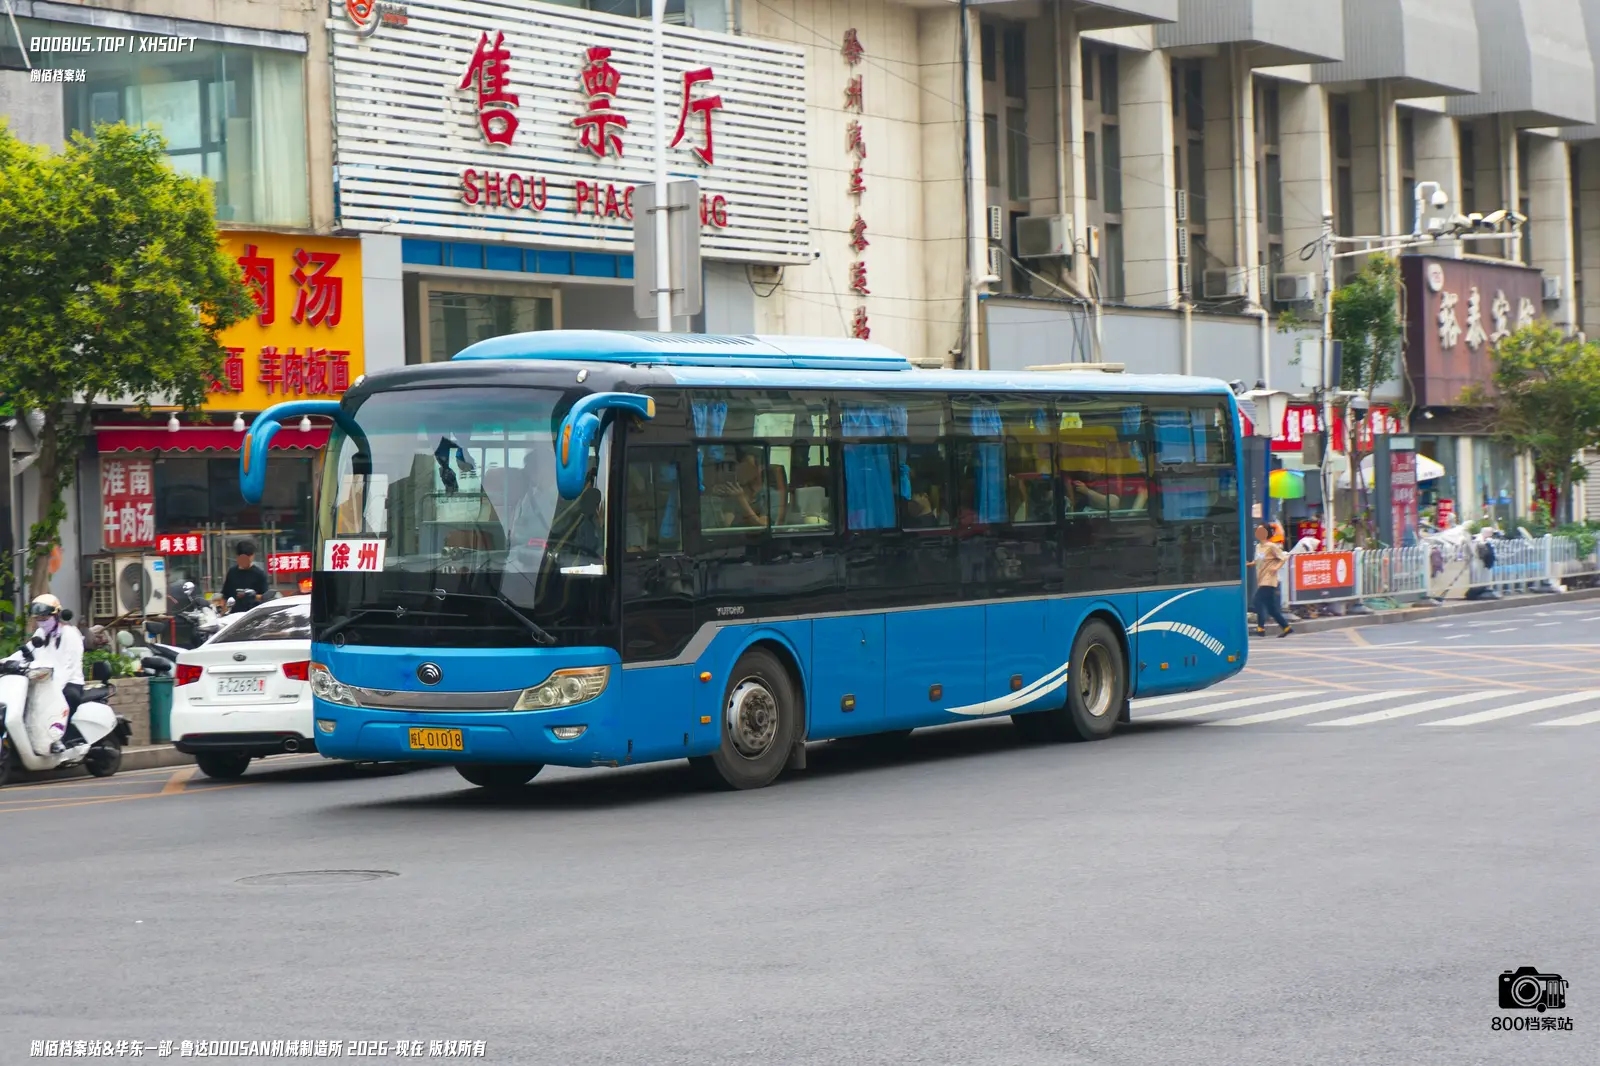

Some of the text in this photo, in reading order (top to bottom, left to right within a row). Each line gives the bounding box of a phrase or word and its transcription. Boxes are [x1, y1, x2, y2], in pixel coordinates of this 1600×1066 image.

[458, 30, 723, 166] 售票厅
[461, 168, 548, 211] SHOU
[258, 346, 351, 395] 羊肉板面
[102, 461, 152, 497] 淮南
[103, 501, 155, 544] 牛肉汤
[159, 536, 200, 553] 肉夹馍
[268, 554, 310, 571] 空调开放
[331, 542, 379, 570] 徐州
